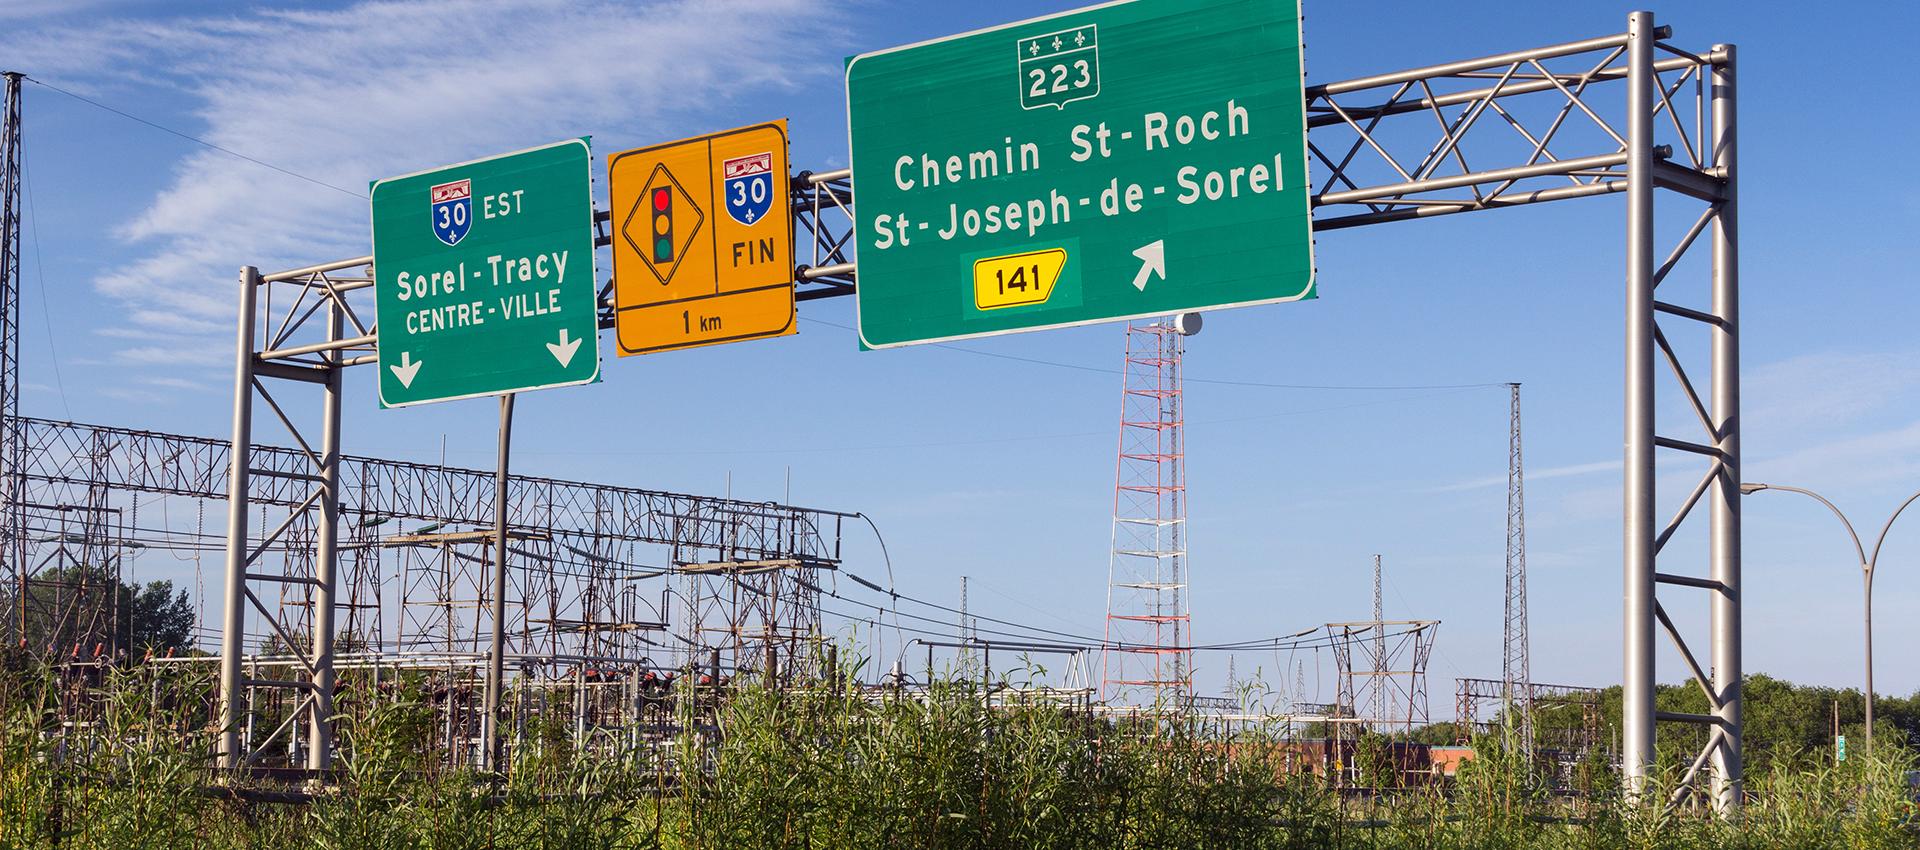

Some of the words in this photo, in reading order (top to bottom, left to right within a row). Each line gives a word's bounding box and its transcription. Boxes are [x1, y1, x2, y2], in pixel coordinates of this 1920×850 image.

[1029, 60, 1091, 98] 223
[894, 136, 1040, 191] Chemin
[732, 179, 767, 206] 30
[438, 203, 467, 230] 30
[483, 190, 525, 219] EST
[732, 237, 776, 268] FIN
[995, 264, 1041, 296] 141
[682, 310, 690, 334] 1
[699, 313, 722, 332] km
